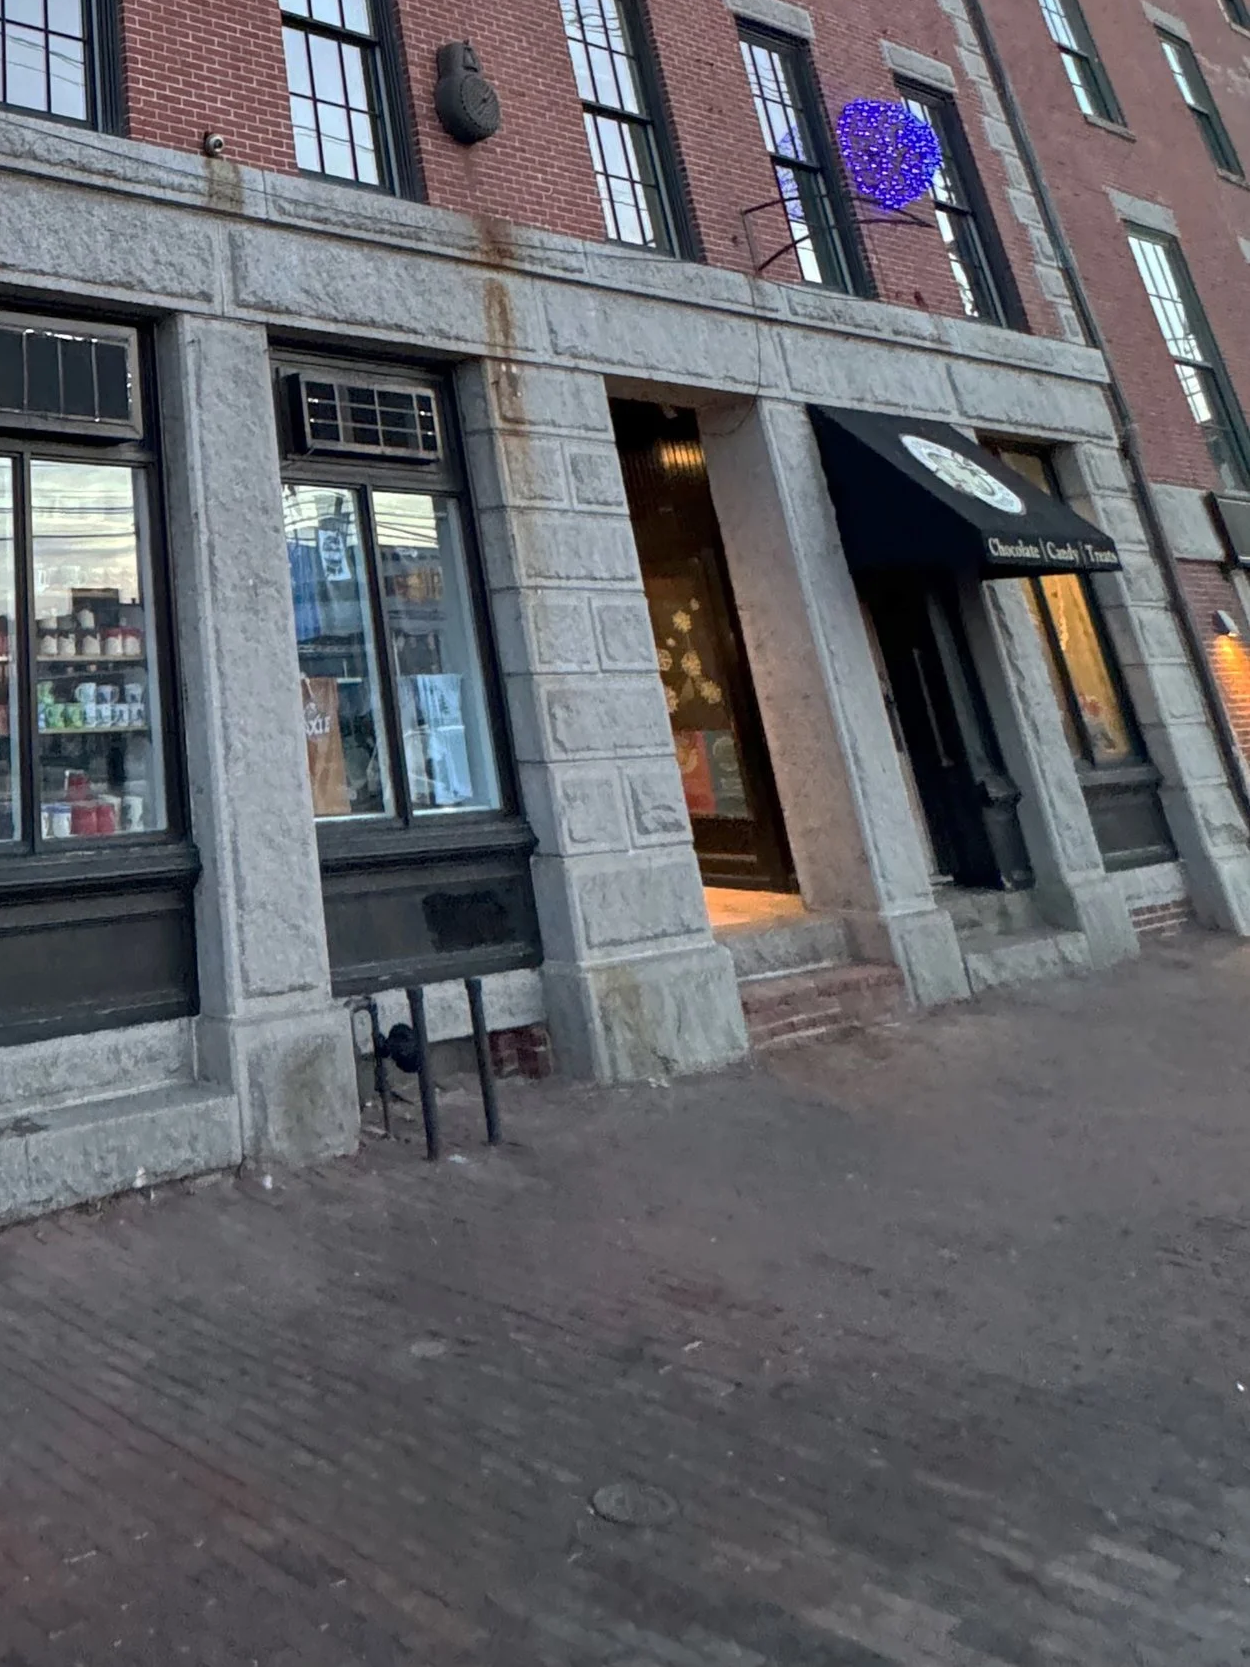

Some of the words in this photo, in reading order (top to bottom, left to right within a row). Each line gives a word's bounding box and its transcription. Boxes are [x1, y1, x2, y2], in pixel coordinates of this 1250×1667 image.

[988, 537, 1041, 559] Chocolate
[1046, 541, 1080, 566] Candy
[1085, 544, 1119, 564] Treats
